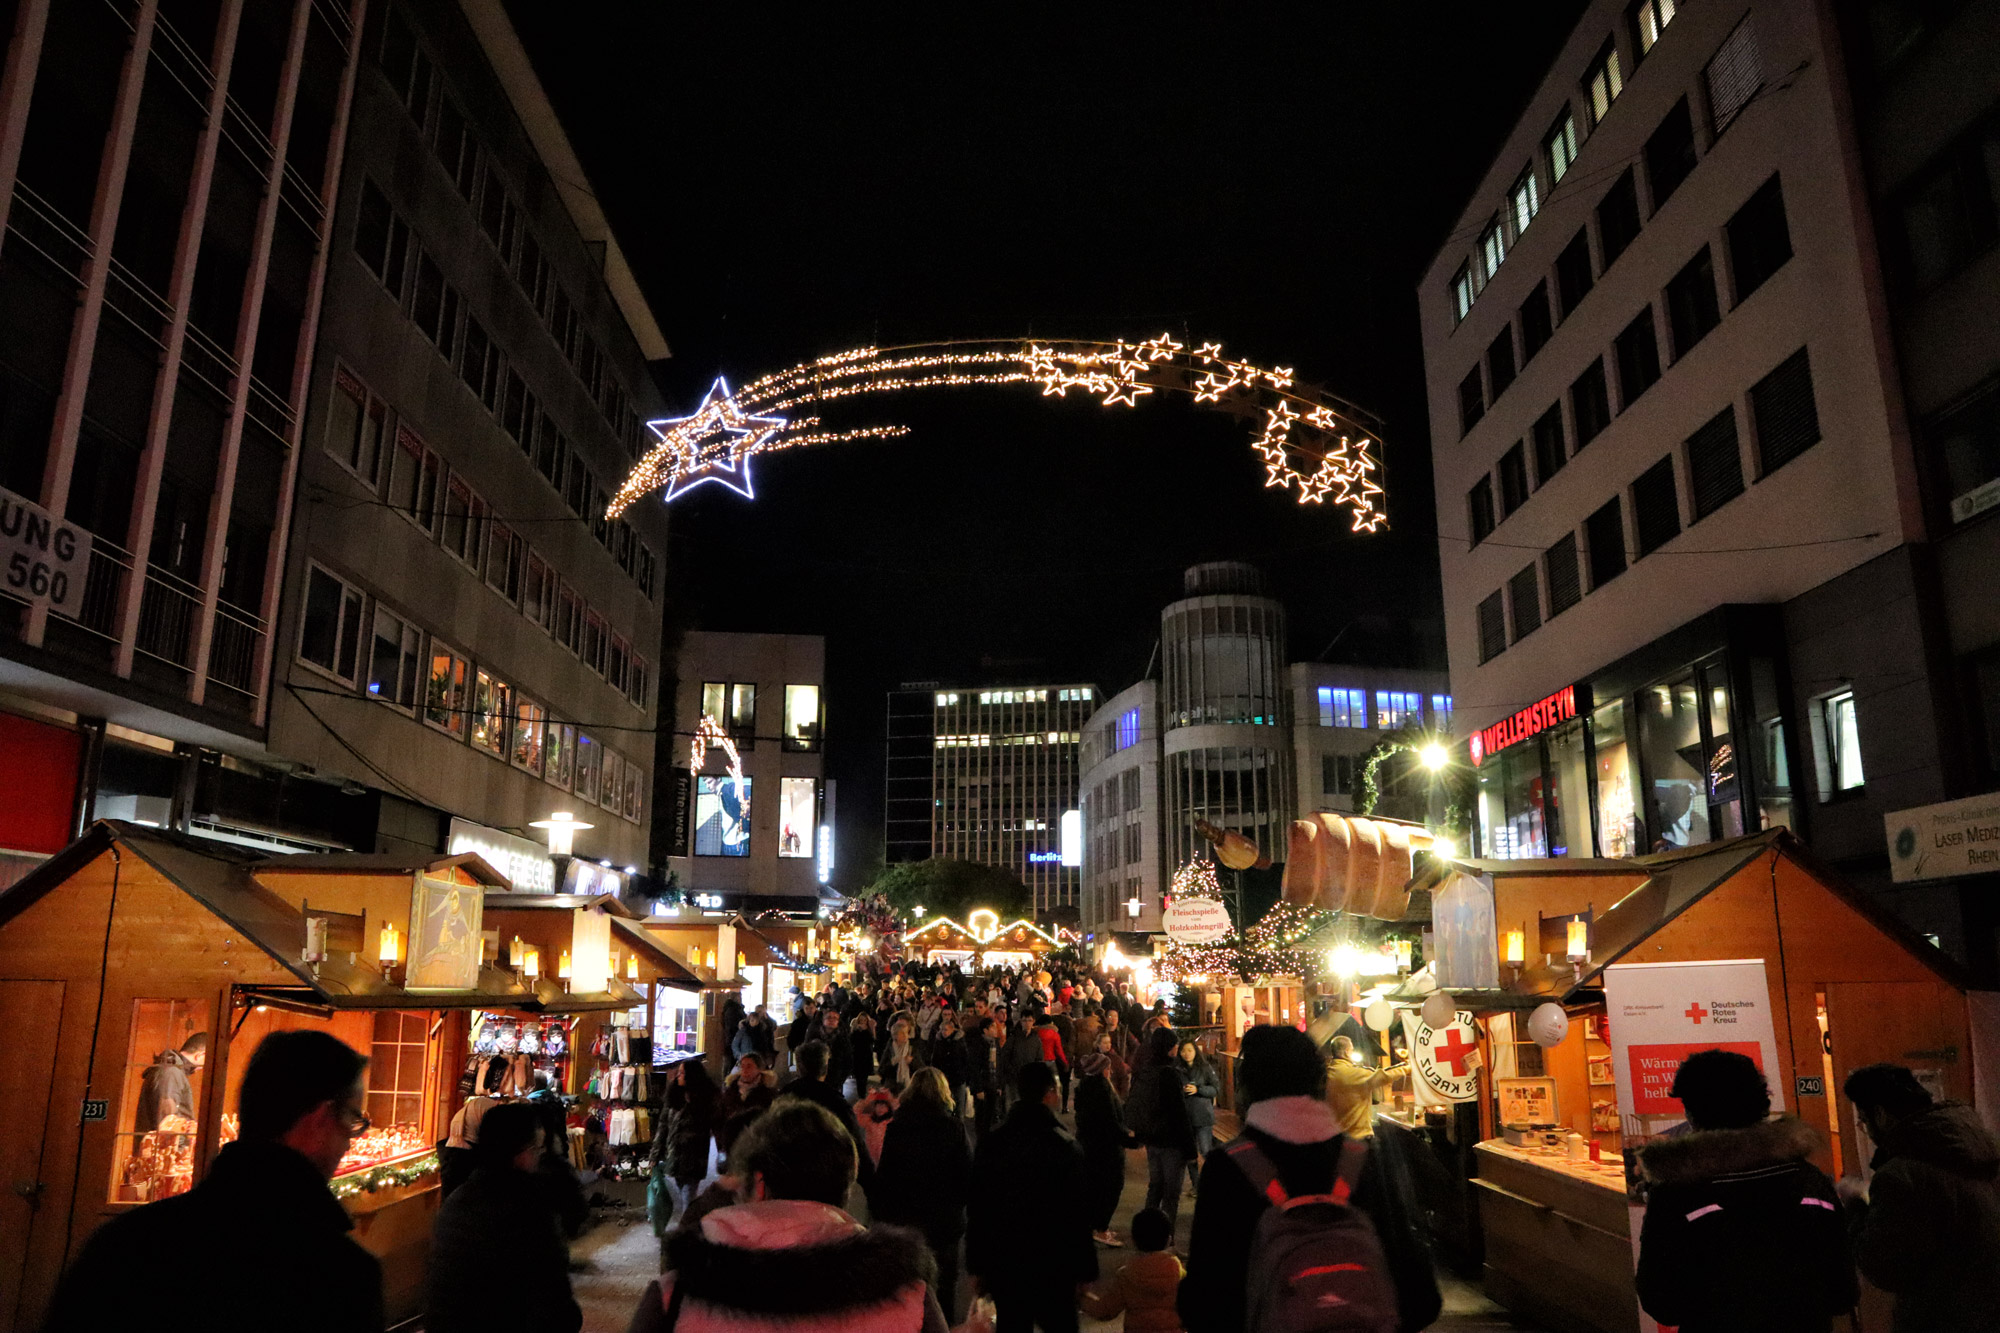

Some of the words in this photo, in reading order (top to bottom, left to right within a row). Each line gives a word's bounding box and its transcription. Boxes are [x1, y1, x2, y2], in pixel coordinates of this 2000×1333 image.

[0, 500, 76, 562] UNG
[7, 551, 68, 604] 560
[1483, 684, 1576, 756] WELLENSTEYN
[1030, 852, 1062, 862] Berlitz
[1172, 908, 1219, 916] Fleischspieße
[1169, 923, 1224, 932] Holzkohlengrill
[1711, 1000, 1755, 1009] Deutsches
[1712, 1008, 1737, 1017] Rotes
[1713, 1016, 1737, 1025] Kreuz
[1642, 1072, 1660, 1084] im
[1661, 1072, 1677, 1083] W
[1799, 1079, 1820, 1092] 240
[1643, 1087, 1671, 1099] helf
[84, 1103, 104, 1116] 231
